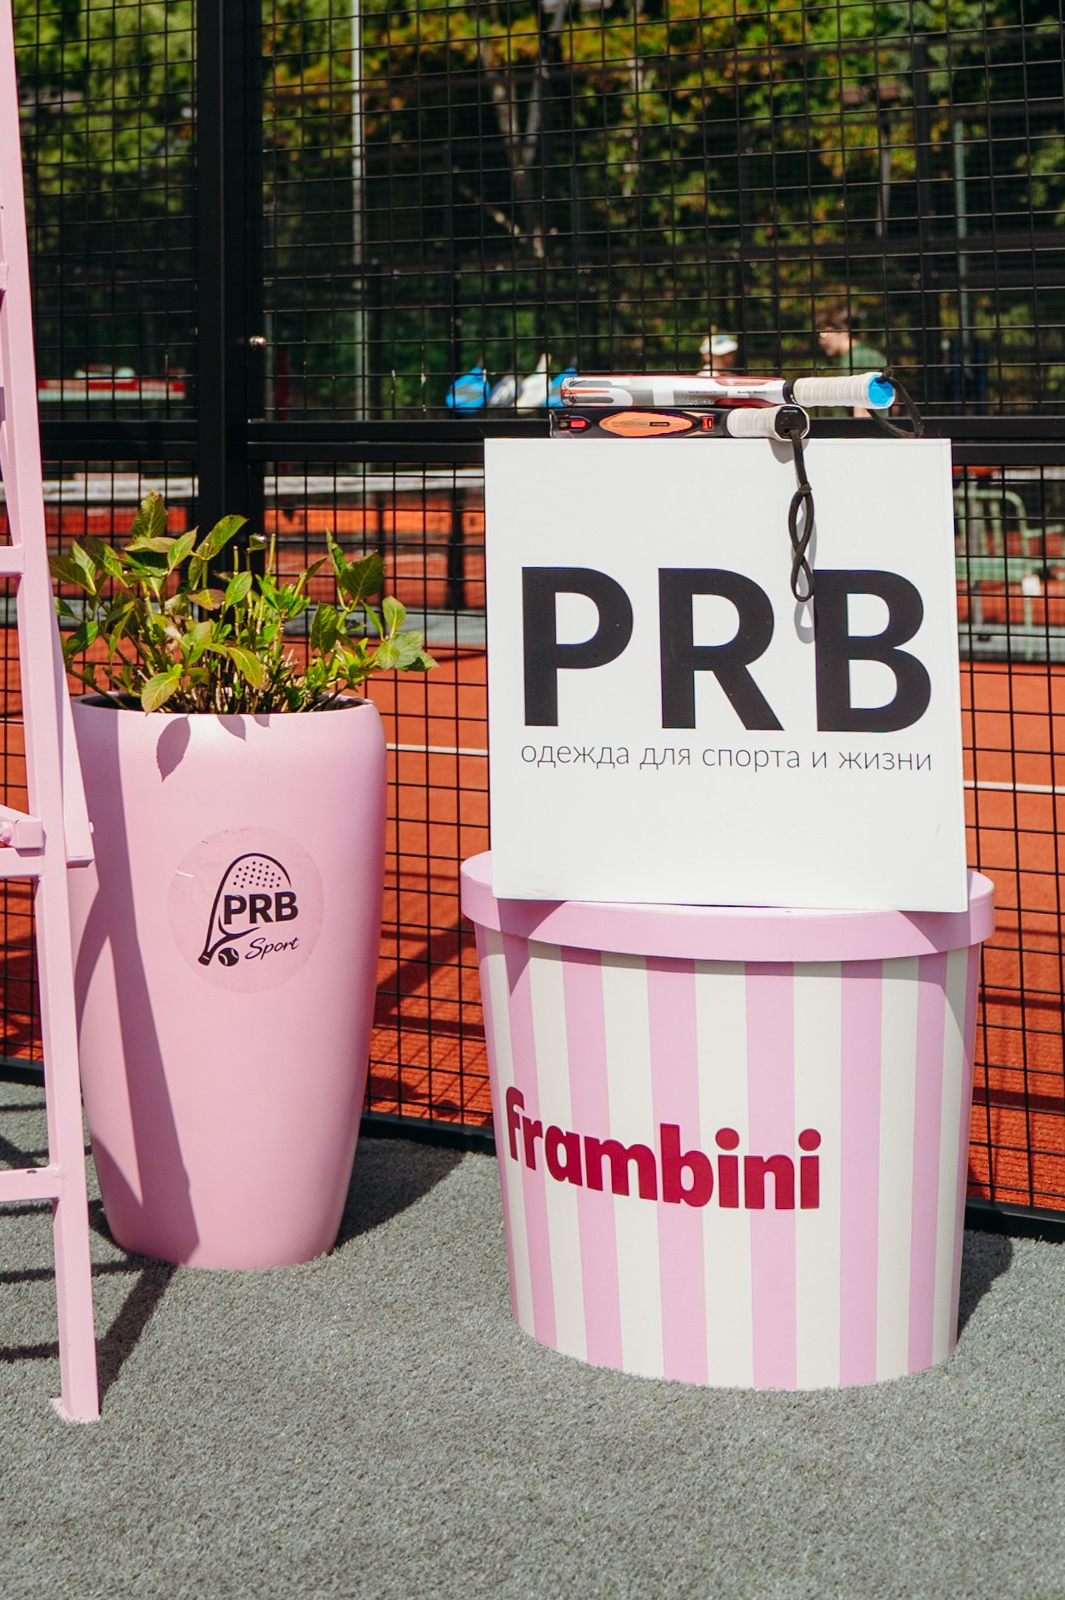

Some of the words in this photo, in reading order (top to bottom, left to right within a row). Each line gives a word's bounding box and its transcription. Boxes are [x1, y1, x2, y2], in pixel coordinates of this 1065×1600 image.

[521, 566, 932, 733] PRB
[520, 744, 630, 769] одежда
[639, 747, 691, 770] для
[701, 748, 800, 773] спорта
[811, 751, 828, 769] и
[838, 752, 932, 772] жизни
[223, 891, 299, 925] PRB
[244, 936, 300, 960] Sport
[505, 1086, 822, 1210] frambini
